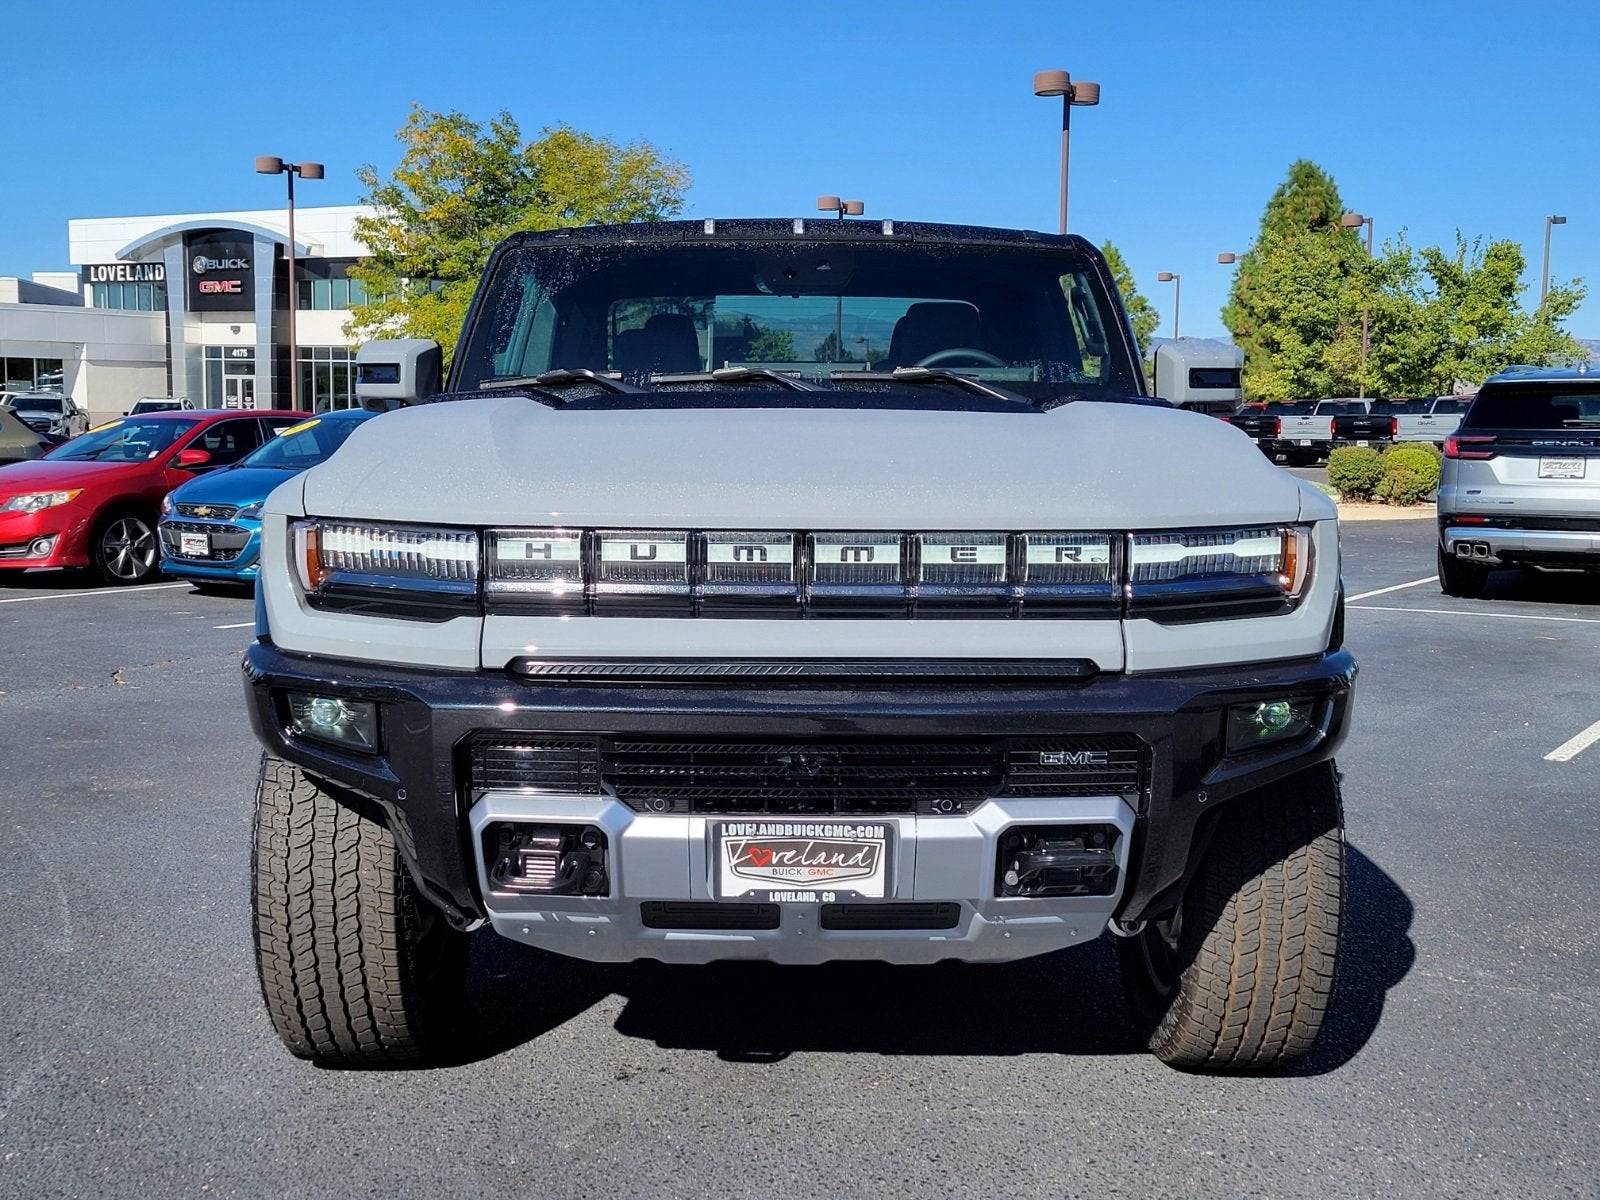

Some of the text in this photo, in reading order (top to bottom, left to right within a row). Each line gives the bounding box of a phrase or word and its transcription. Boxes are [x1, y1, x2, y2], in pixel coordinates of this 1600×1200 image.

[206, 258, 250, 270] BUICK
[90, 264, 164, 282] LOVELAND
[200, 280, 242, 293] GMC
[231, 348, 248, 357] 4175
[1040, 750, 1108, 765] GMC
[772, 868, 835, 876] BUICK GMC
[769, 892, 836, 903] LOVELAND, CO
